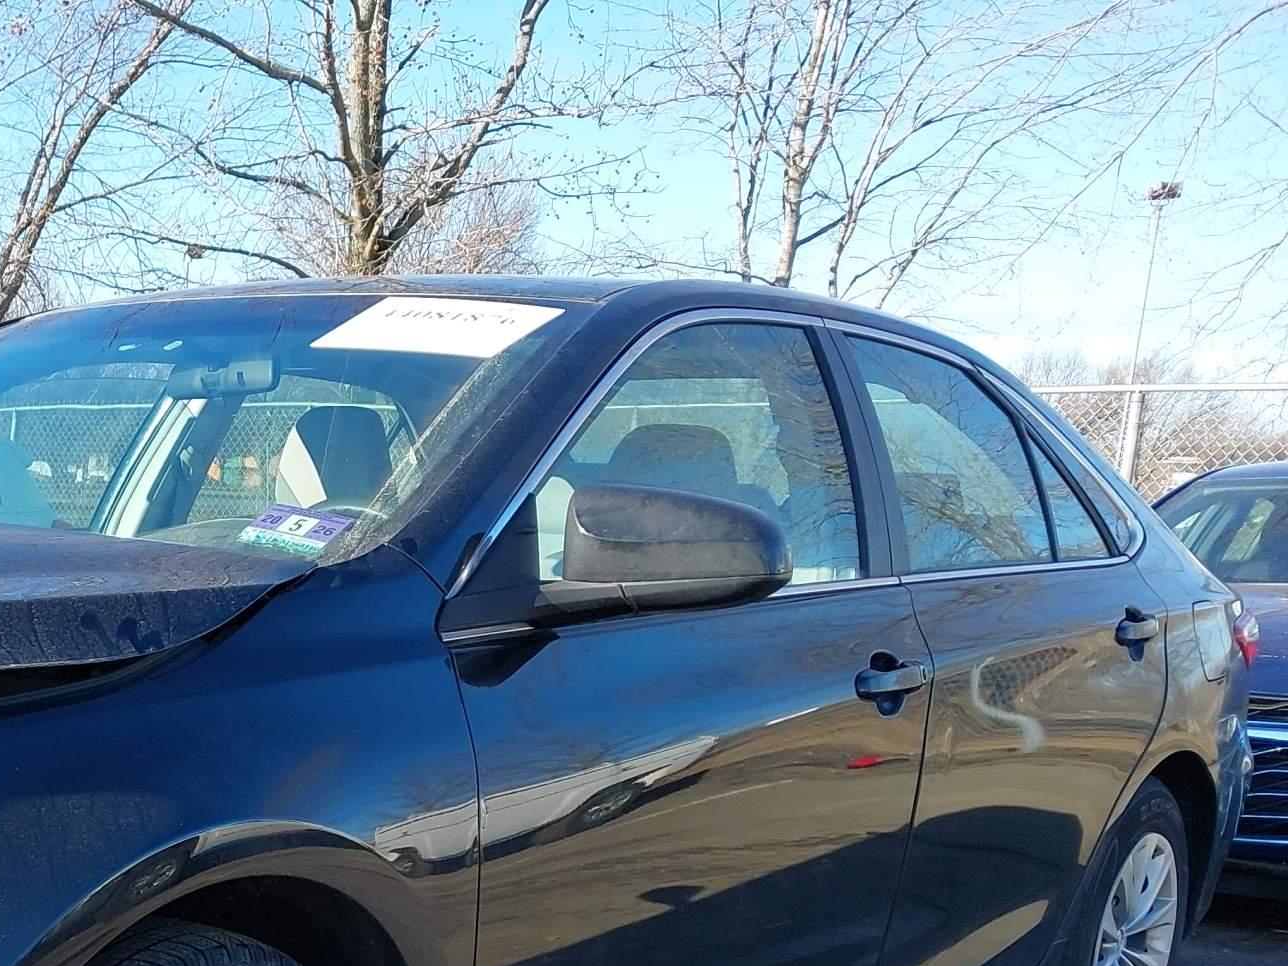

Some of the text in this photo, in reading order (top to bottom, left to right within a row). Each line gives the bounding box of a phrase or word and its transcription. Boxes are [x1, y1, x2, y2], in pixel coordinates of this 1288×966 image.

[261, 514, 337, 536] 20 5 26
